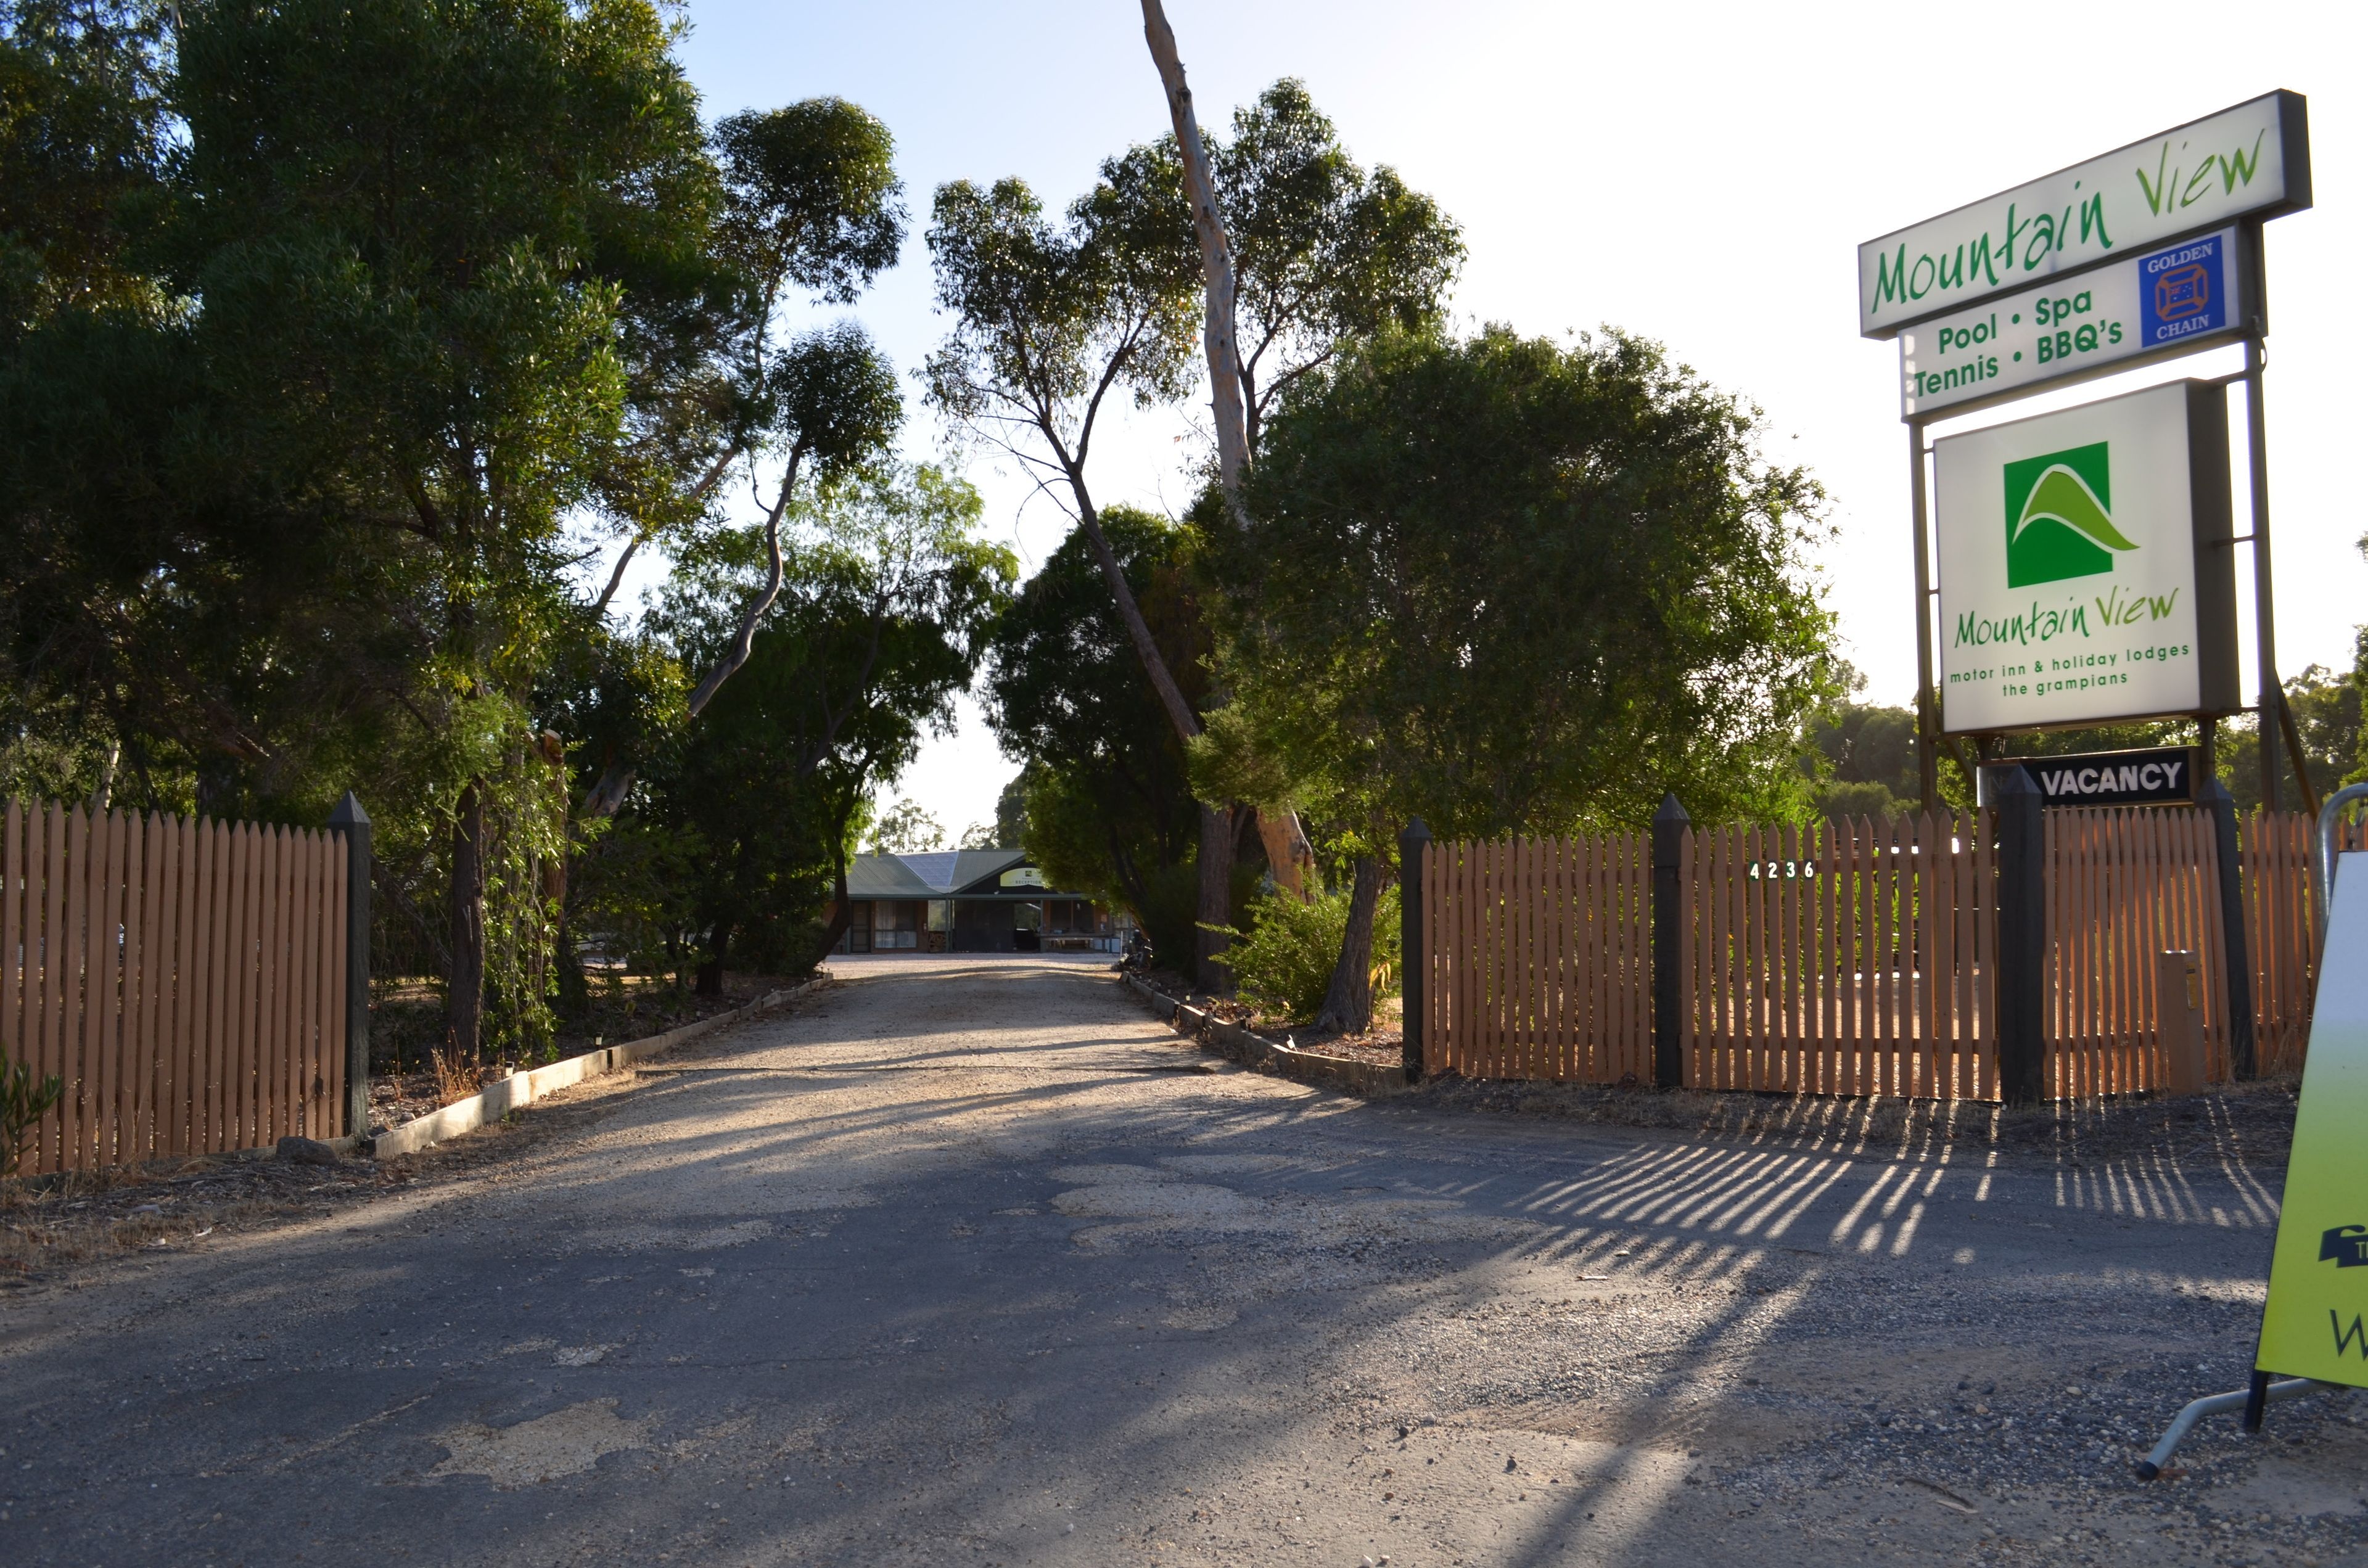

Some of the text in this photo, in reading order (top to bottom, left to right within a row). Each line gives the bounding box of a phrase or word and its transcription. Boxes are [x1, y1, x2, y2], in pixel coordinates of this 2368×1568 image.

[1871, 128, 2266, 314] Mountain View
[2147, 242, 2213, 273] GOLDEN
[1939, 290, 2092, 355] Pool Spa
[2156, 314, 2210, 340] CHAIN
[1914, 319, 2123, 398] Tennis BBQ's
[1954, 585, 2179, 649] Mountain View
[1950, 644, 2189, 683] motor inn & holiday lodges
[2002, 671, 2128, 697] the grampians
[2040, 761, 2182, 796] VACANCY
[1749, 861, 1814, 880] 4236
